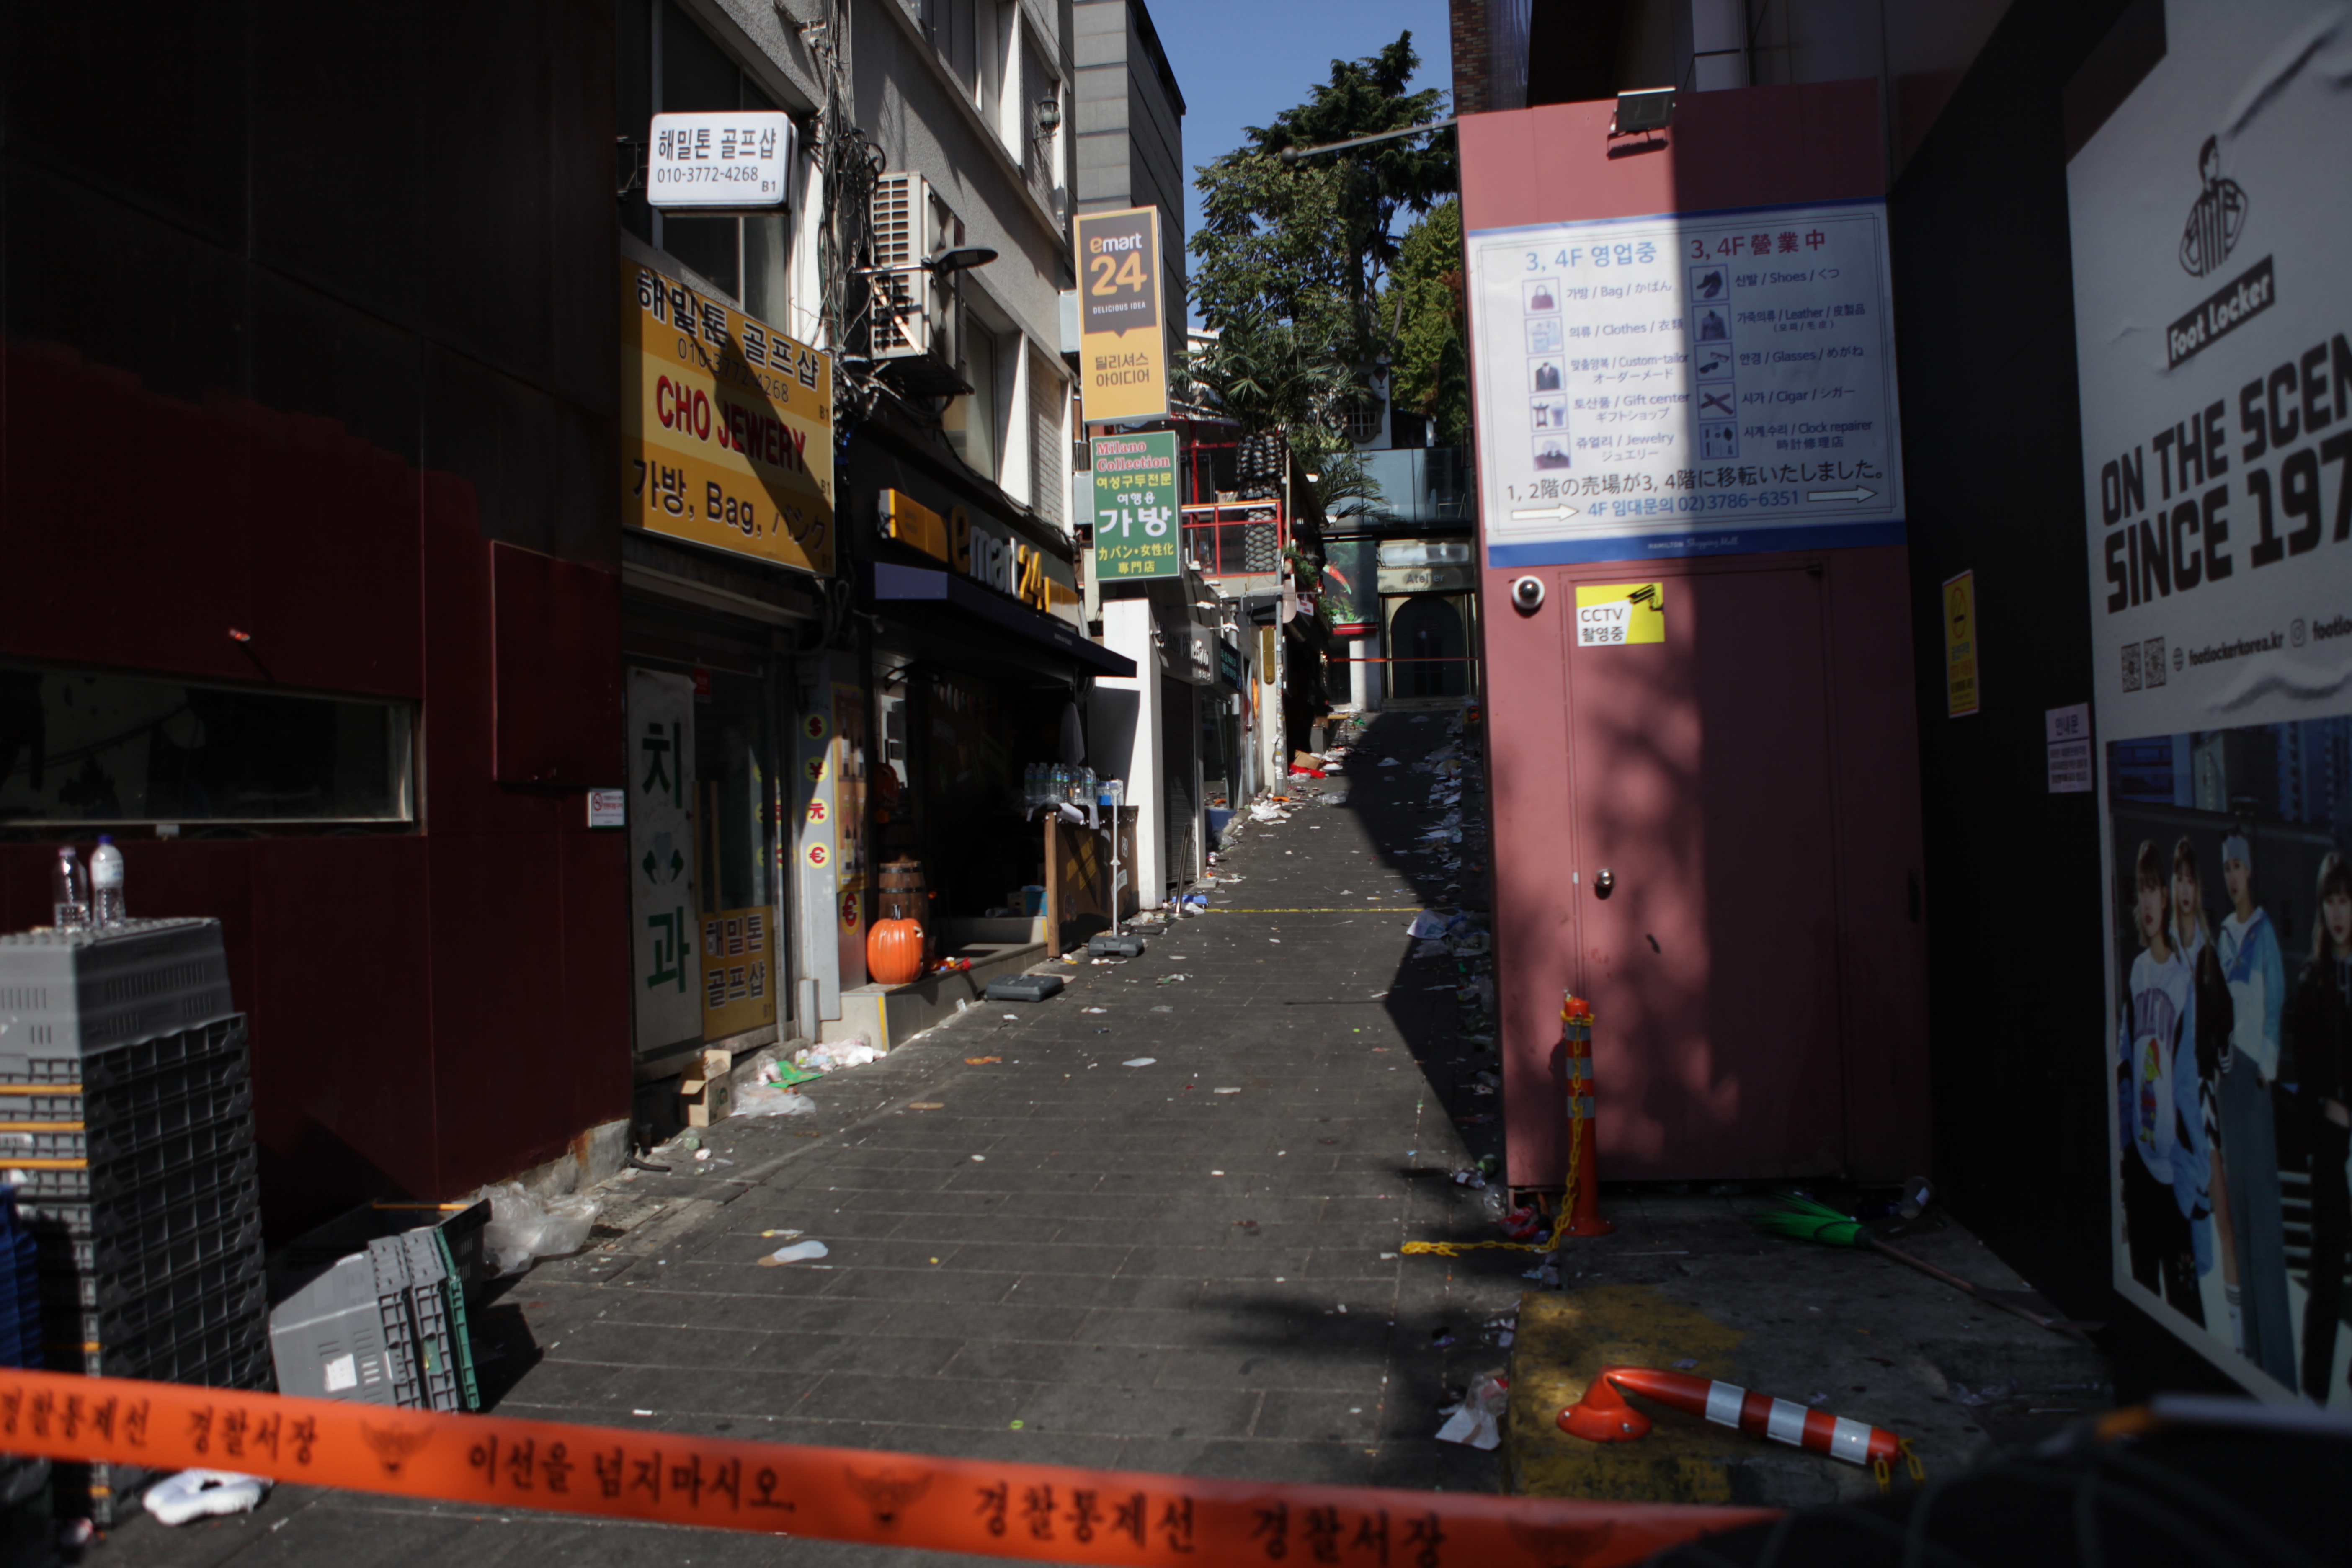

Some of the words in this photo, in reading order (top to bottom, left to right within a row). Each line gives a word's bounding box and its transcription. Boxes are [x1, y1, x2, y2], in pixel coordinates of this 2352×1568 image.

[659, 129, 711, 161] 해밀톤
[721, 128, 776, 160] 골프샵
[658, 166, 758, 183] 010-3772-4268
[762, 180, 776, 193] B1
[1090, 232, 1142, 254] emart
[1717, 236, 1745, 257] 4F
[1555, 248, 1583, 268] 4F
[1591, 242, 1656, 268] 영업중
[1090, 251, 1148, 297] 24
[1735, 273, 1758, 288] 신발
[1770, 271, 1807, 284] Shoes
[1818, 268, 1840, 280] くつ
[1567, 287, 1589, 300] 가방
[1600, 286, 1623, 299] Bag
[1635, 281, 1672, 294] かばん
[1093, 303, 1128, 315] DELICIOUS
[1130, 301, 1146, 310] IDEA
[1737, 309, 1776, 325] 가죽의류
[1785, 307, 1824, 321] Leather
[2170, 312, 2206, 361] Foot
[2208, 273, 2270, 336] Locker
[636, 271, 729, 350] 해밀톤
[742, 320, 820, 392] 골프샵
[1569, 325, 1591, 339] 의류
[1603, 322, 1647, 336] Clothes
[1095, 352, 1149, 371] 딜리셔스
[1619, 353, 1689, 368] Custom-tailor
[1739, 352, 1761, 366] 안경
[1772, 351, 1817, 363] Glasses
[1827, 345, 1864, 358] めがね
[677, 337, 789, 403] 010-3772-4268
[1096, 368, 1150, 387] 아이디어
[1573, 396, 1610, 410] 토산품
[1623, 393, 1647, 406] Gift
[1649, 393, 1691, 405] center
[1742, 391, 1765, 405] 시가
[1777, 390, 1808, 405] Cigar
[1821, 386, 1855, 399] シガー
[656, 375, 711, 443] CHO
[717, 400, 807, 475] JEWERY
[1798, 421, 1828, 434] Clock
[1830, 420, 1873, 435] repairer
[1096, 441, 1147, 456] Milano
[1626, 432, 1674, 446] Jewelry
[1097, 454, 1171, 472] Collection
[2101, 445, 2145, 527] ON
[2152, 399, 2229, 501] THE
[1096, 472, 1172, 490] 여성구두전문
[633, 459, 694, 521] 가방,
[707, 481, 762, 539] Bag,
[1117, 491, 1155, 505] 여행용
[1588, 502, 1608, 516] 4F
[1612, 498, 1674, 516] 임대문의
[1678, 490, 1798, 512] 02)3786-6351
[1099, 506, 1172, 537] 가방
[2104, 483, 2233, 615] SINCE
[1406, 573, 1445, 584] Ateler
[1581, 608, 1623, 622] CCTV
[1582, 626, 1624, 642] 촬영중
[705, 913, 764, 959] 해밀톤
[707, 959, 766, 1010] 골프샵
[190, 1405, 318, 1465] 경찰서장
[974, 1481, 1195, 1554] 경찰통제선
